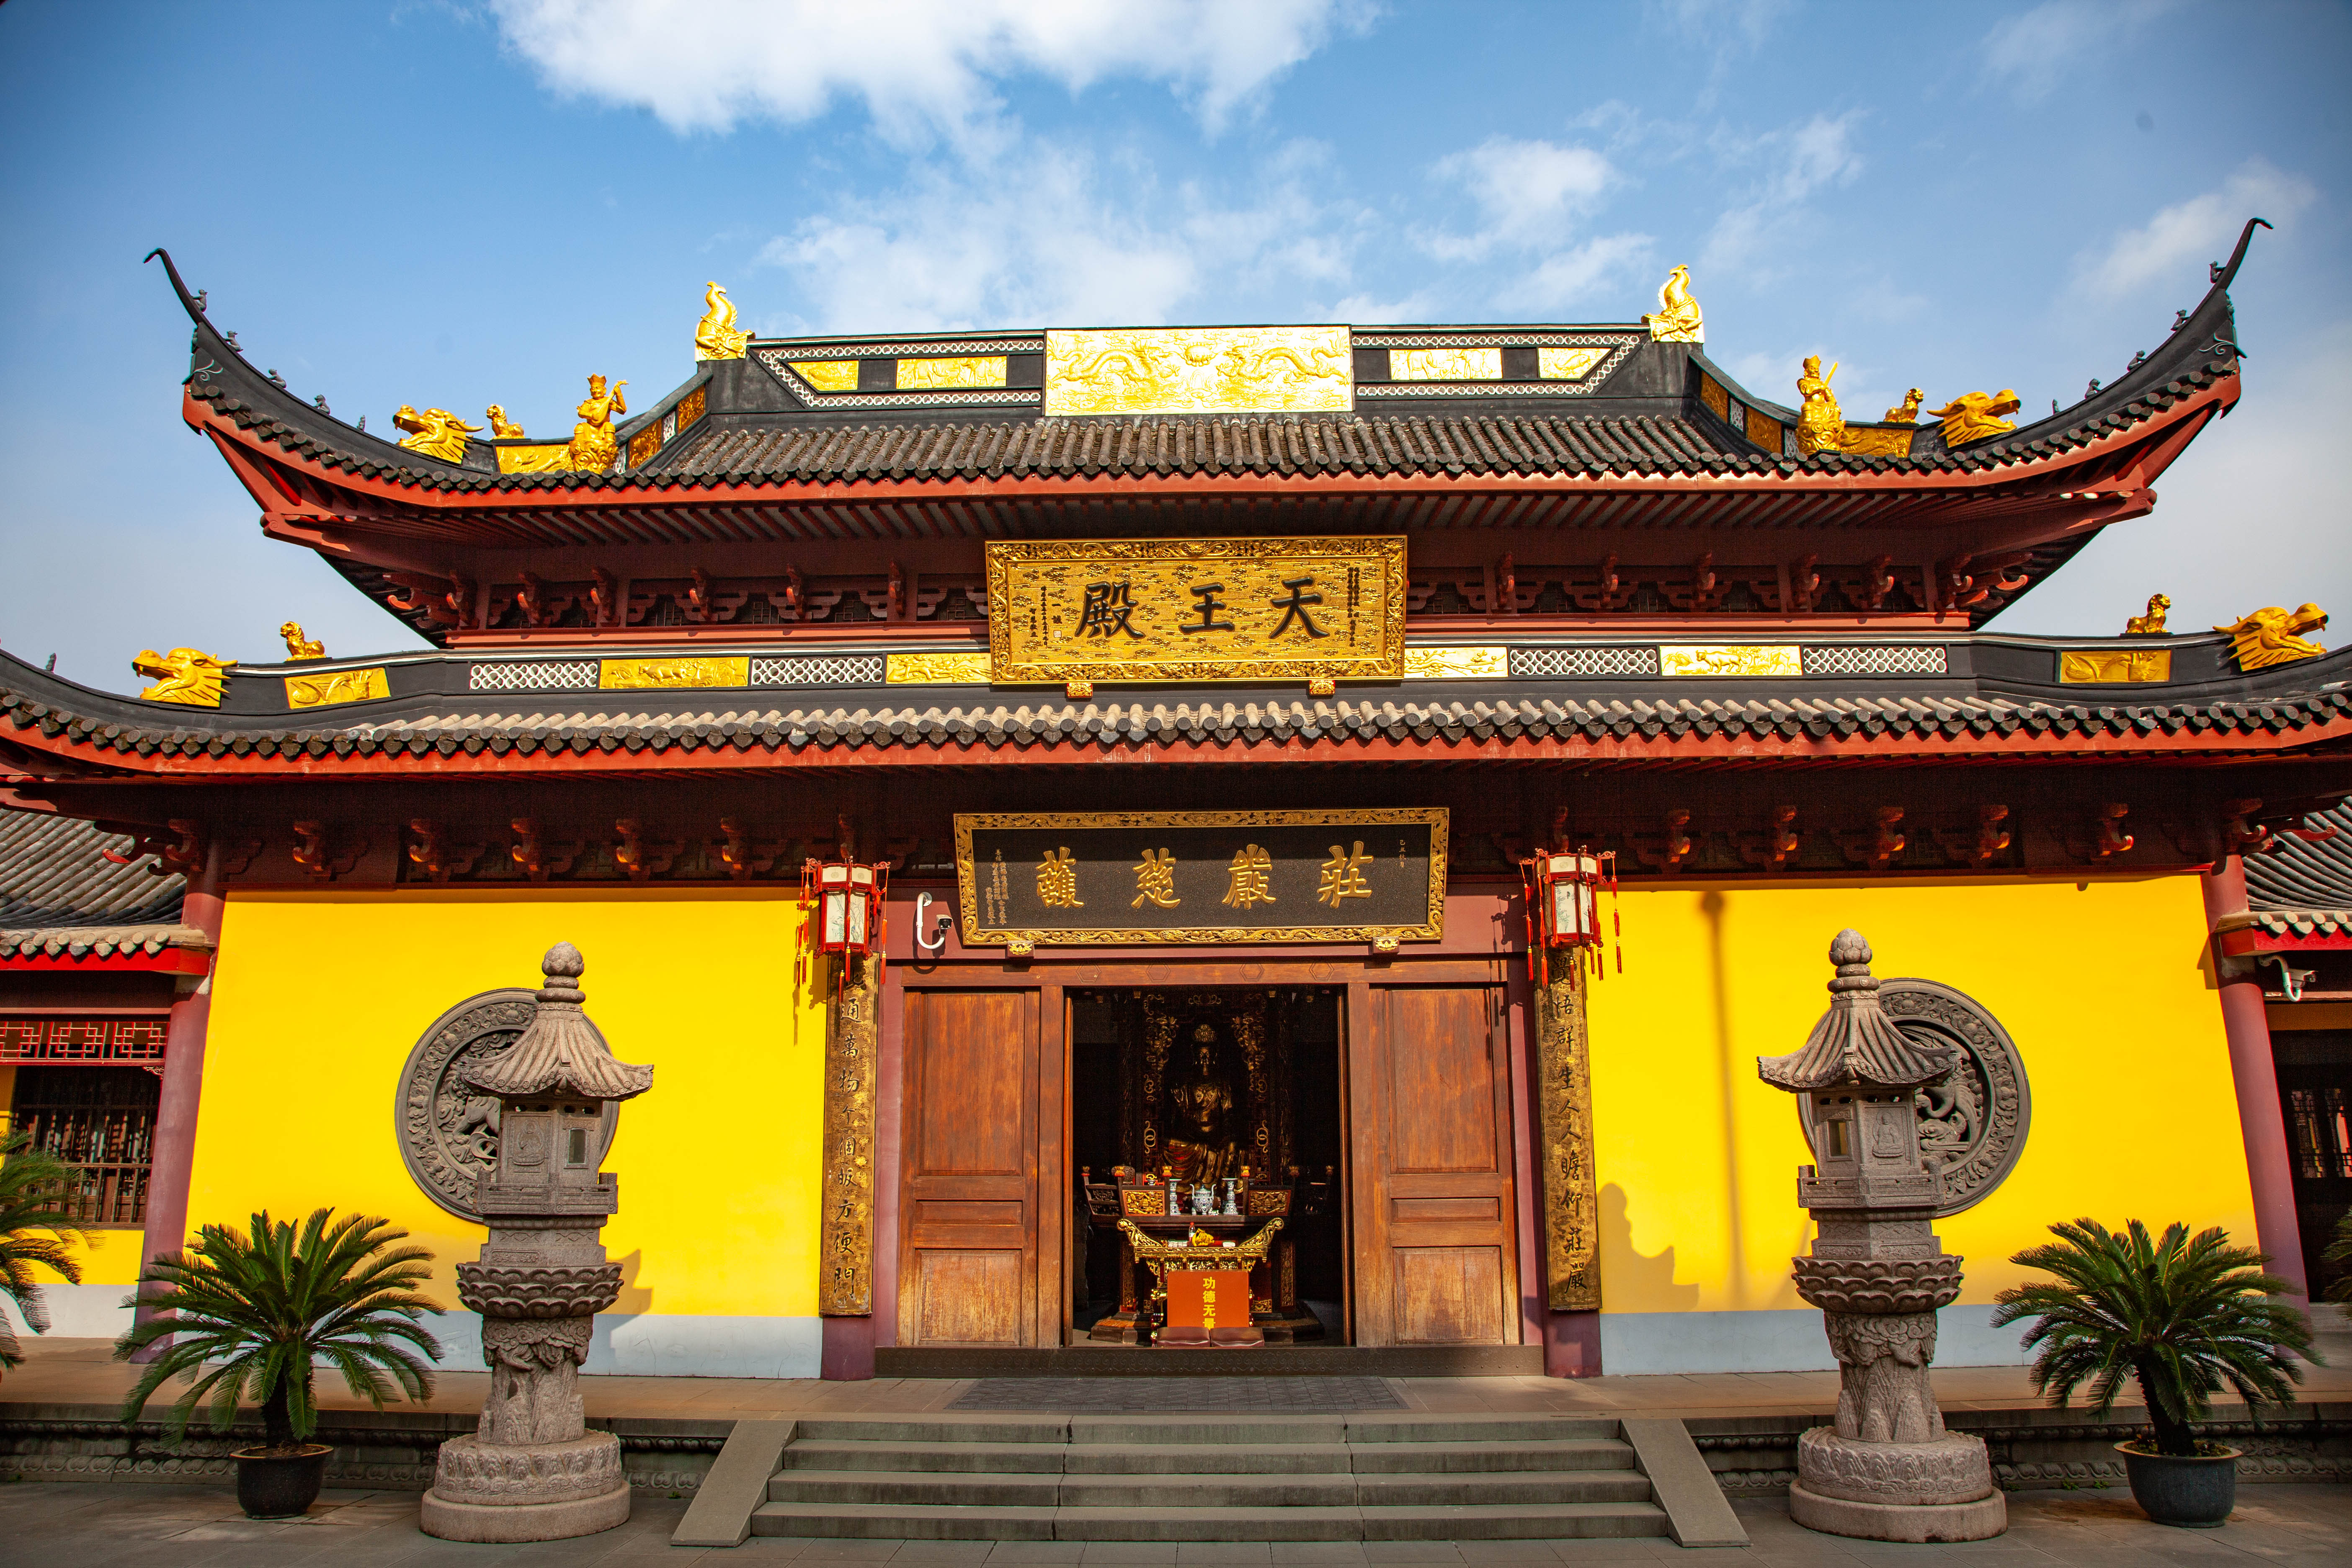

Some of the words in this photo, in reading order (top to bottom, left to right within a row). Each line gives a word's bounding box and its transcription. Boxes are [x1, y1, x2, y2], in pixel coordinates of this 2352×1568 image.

[1075, 576, 1330, 640] 天王殿
[1202, 1276, 1216, 1330] 功德无量
